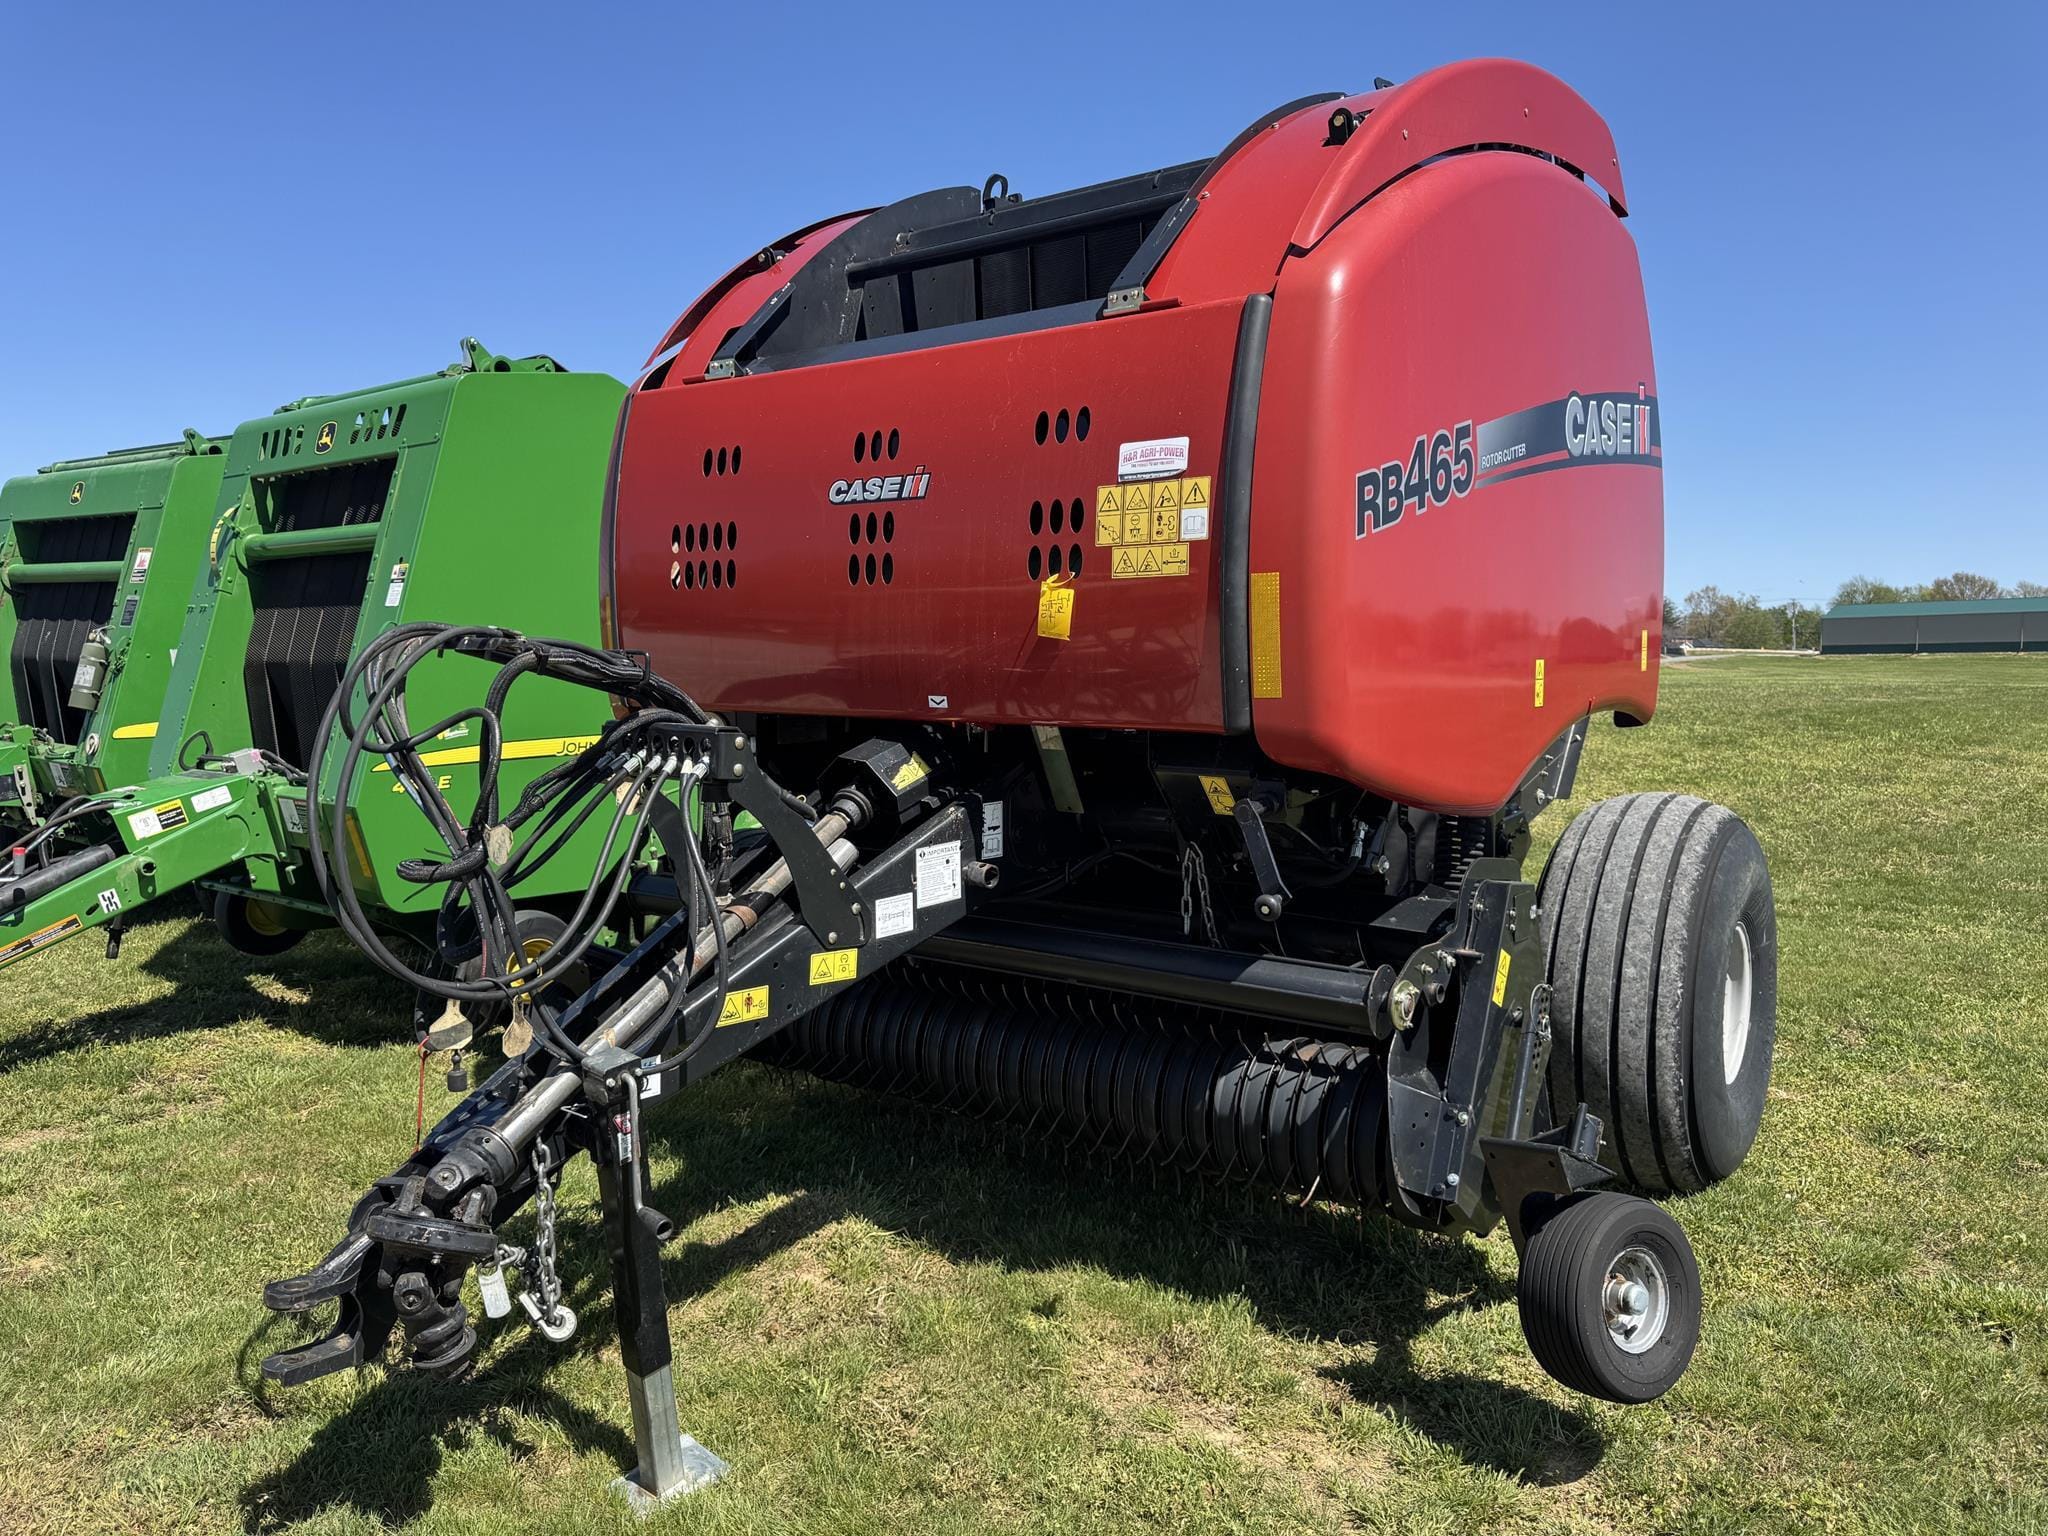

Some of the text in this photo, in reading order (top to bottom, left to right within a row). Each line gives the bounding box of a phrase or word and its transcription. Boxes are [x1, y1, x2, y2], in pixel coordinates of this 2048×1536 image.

[1122, 446, 1184, 464] H&R AGRI-POWER
[1481, 443, 1526, 469] ROTOR CUTTER
[1356, 420, 1474, 540] RB465
